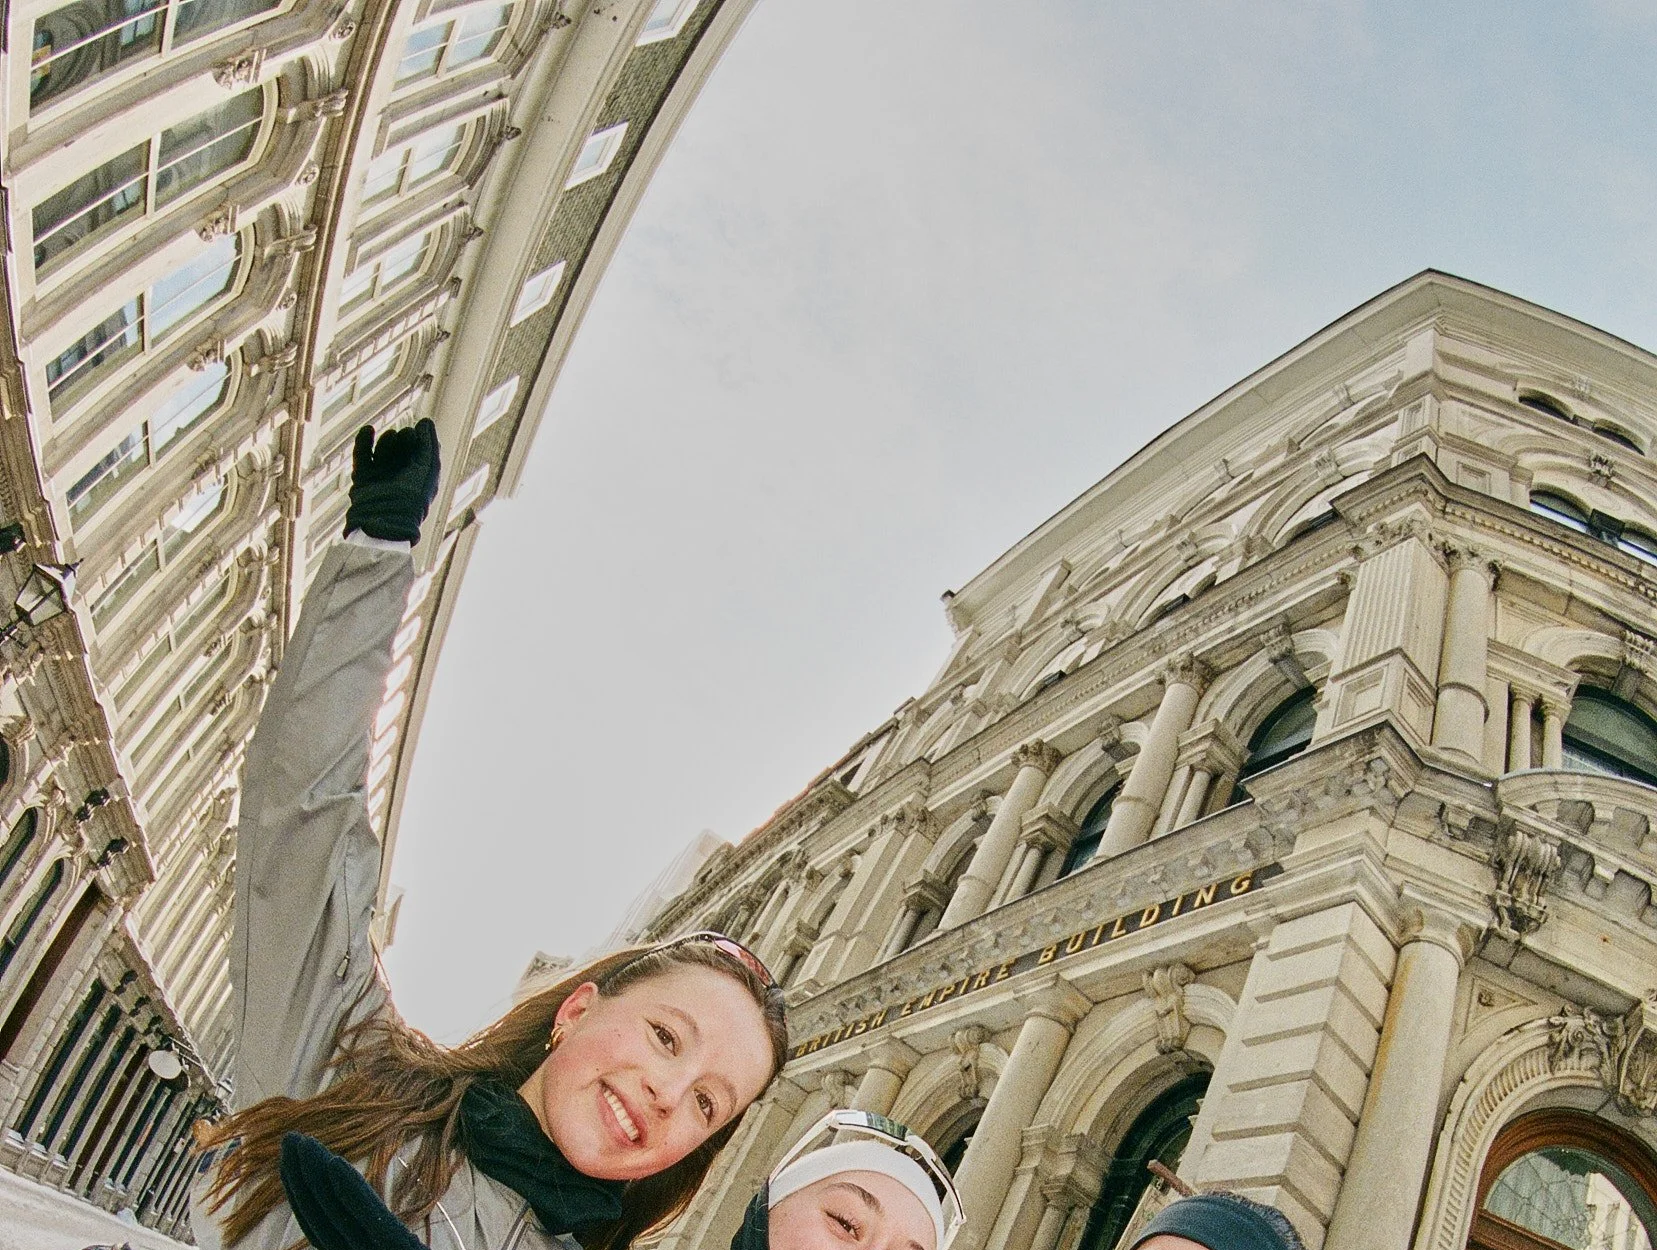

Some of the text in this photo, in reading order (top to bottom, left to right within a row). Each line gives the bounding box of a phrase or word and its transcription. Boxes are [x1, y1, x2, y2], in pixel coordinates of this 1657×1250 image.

[795, 870, 1255, 1058] BRITISH EMPIRE BUILDING
